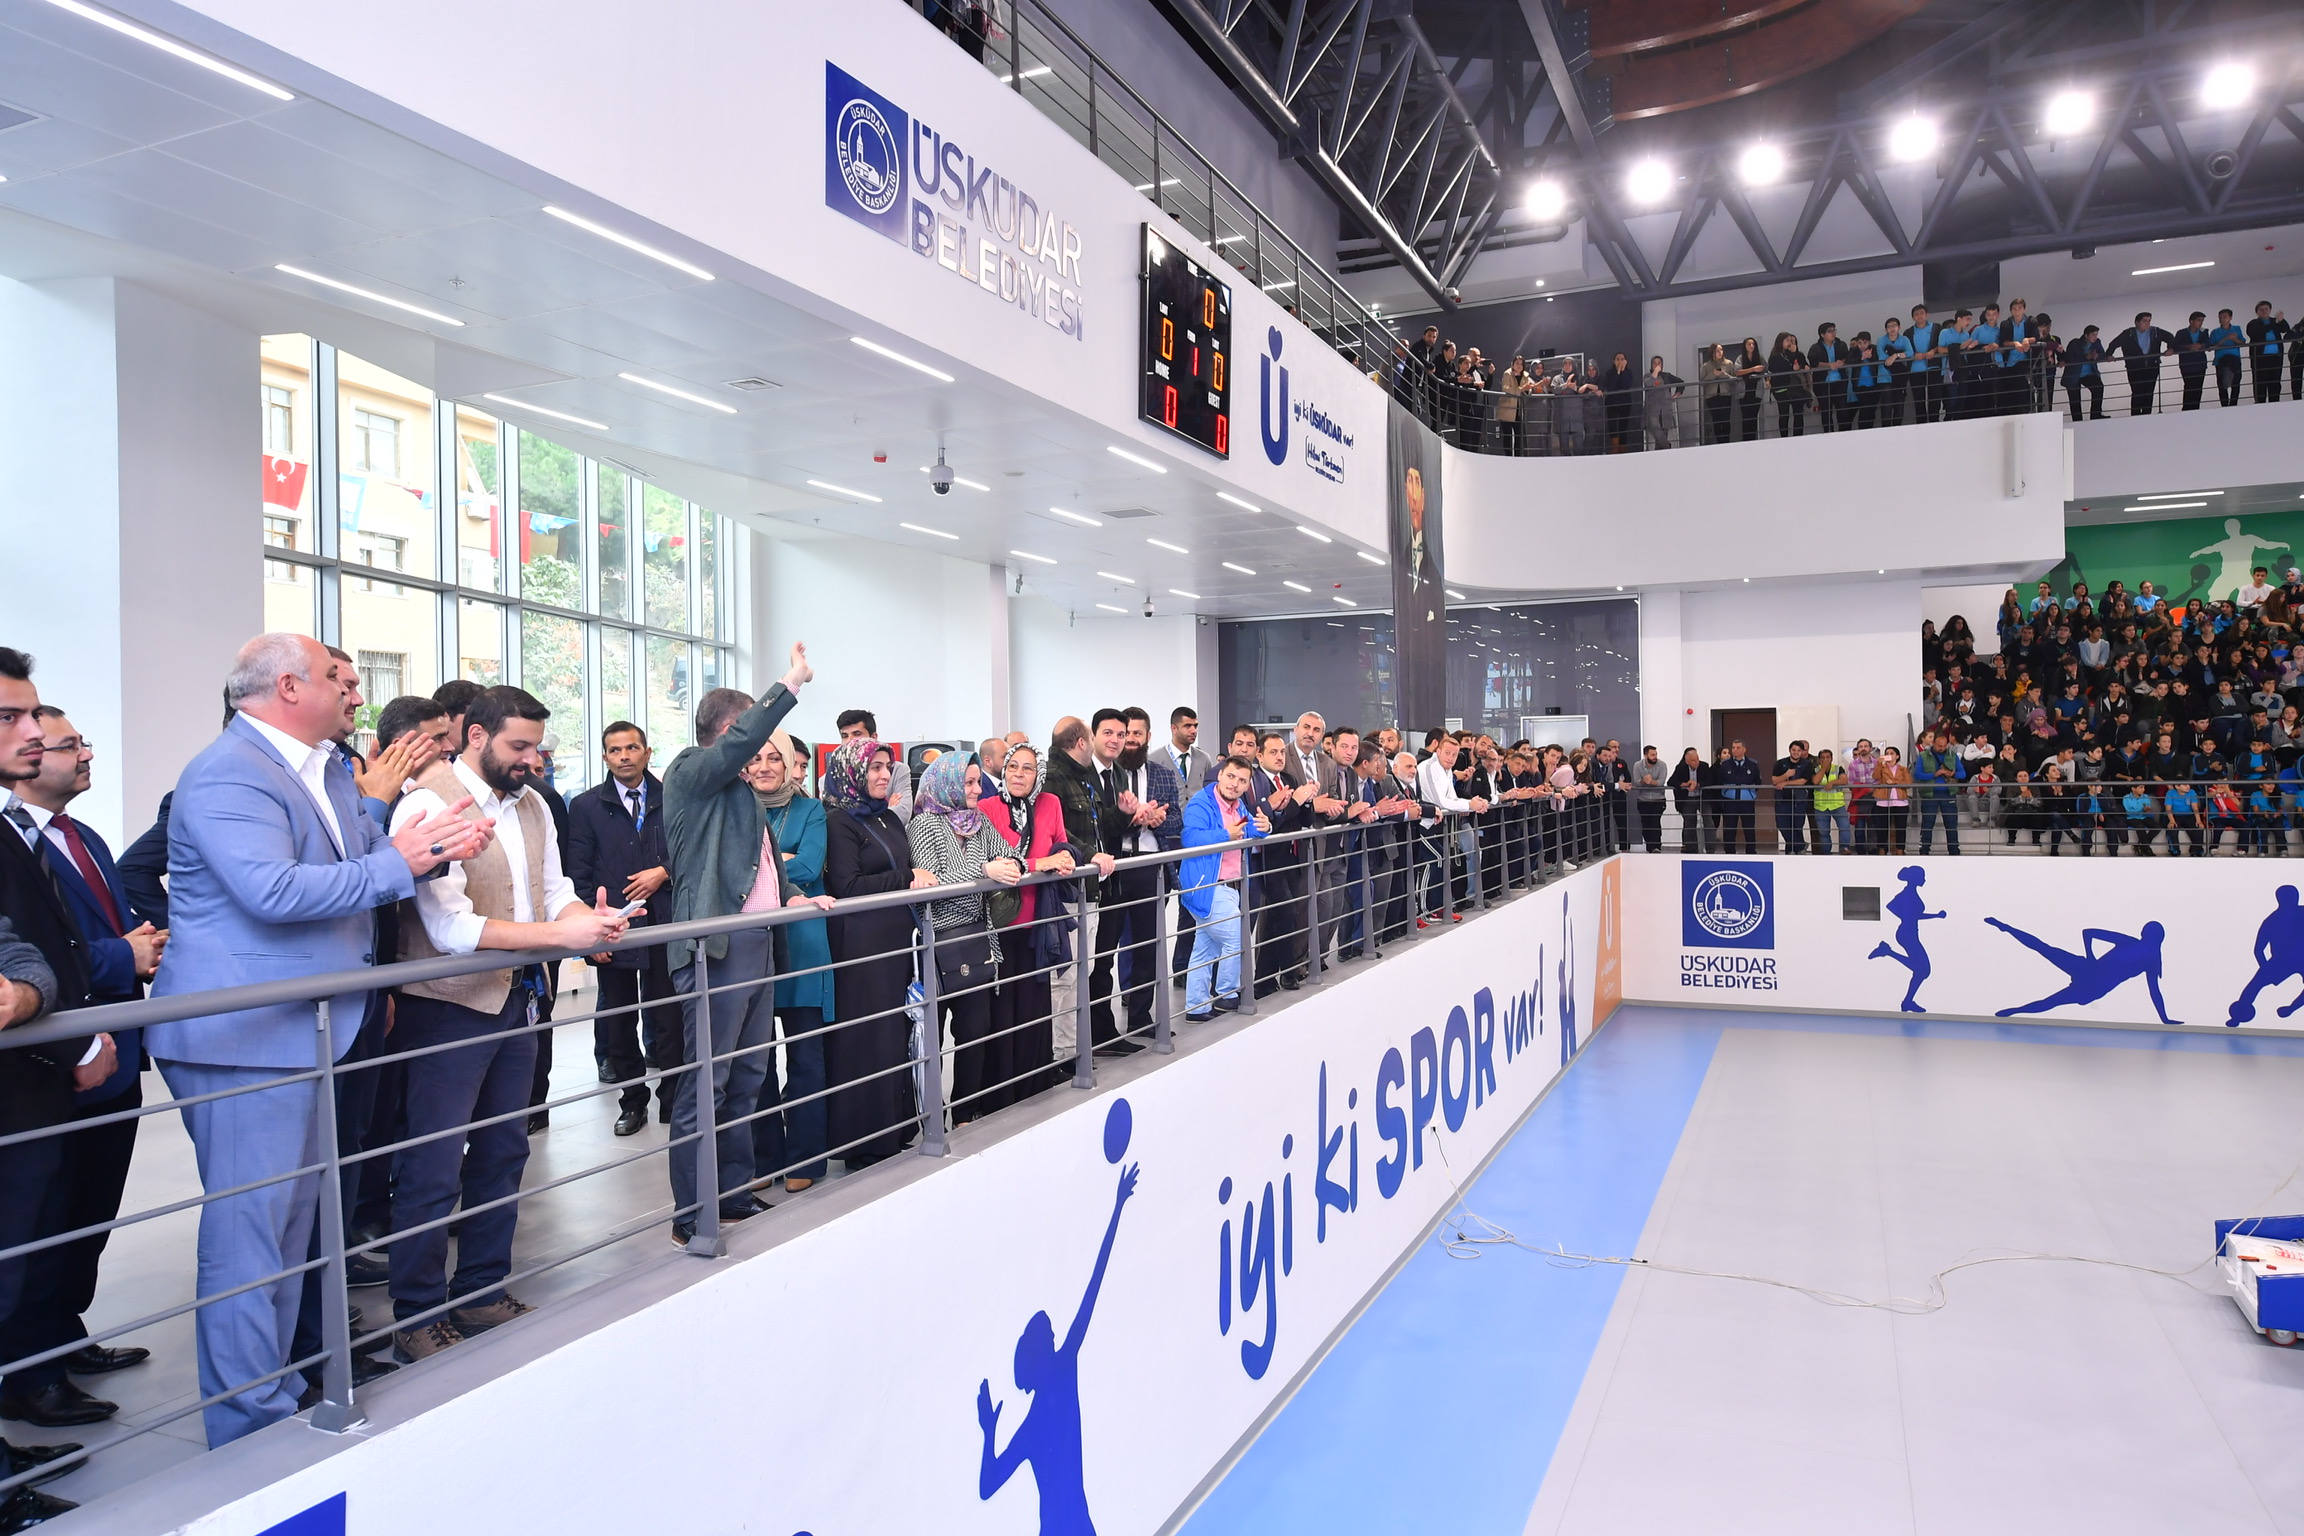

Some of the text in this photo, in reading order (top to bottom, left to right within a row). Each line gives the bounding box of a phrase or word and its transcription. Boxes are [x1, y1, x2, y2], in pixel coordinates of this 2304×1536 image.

[851, 106, 887, 137] ÜSKÜDAR
[912, 117, 1083, 287] ÜSKÜDAR
[1203, 287, 1216, 330] 0
[1161, 316, 1174, 361] 0
[1212, 350, 1225, 392] 0
[1164, 384, 1178, 429] 0
[1215, 413, 1228, 454] 0
[1708, 873, 1749, 888] ÜSKÜDAR
[1680, 954, 1777, 975] ÜSKÜDAR
[1218, 942, 1544, 1380] iyi ki SPOR var!
